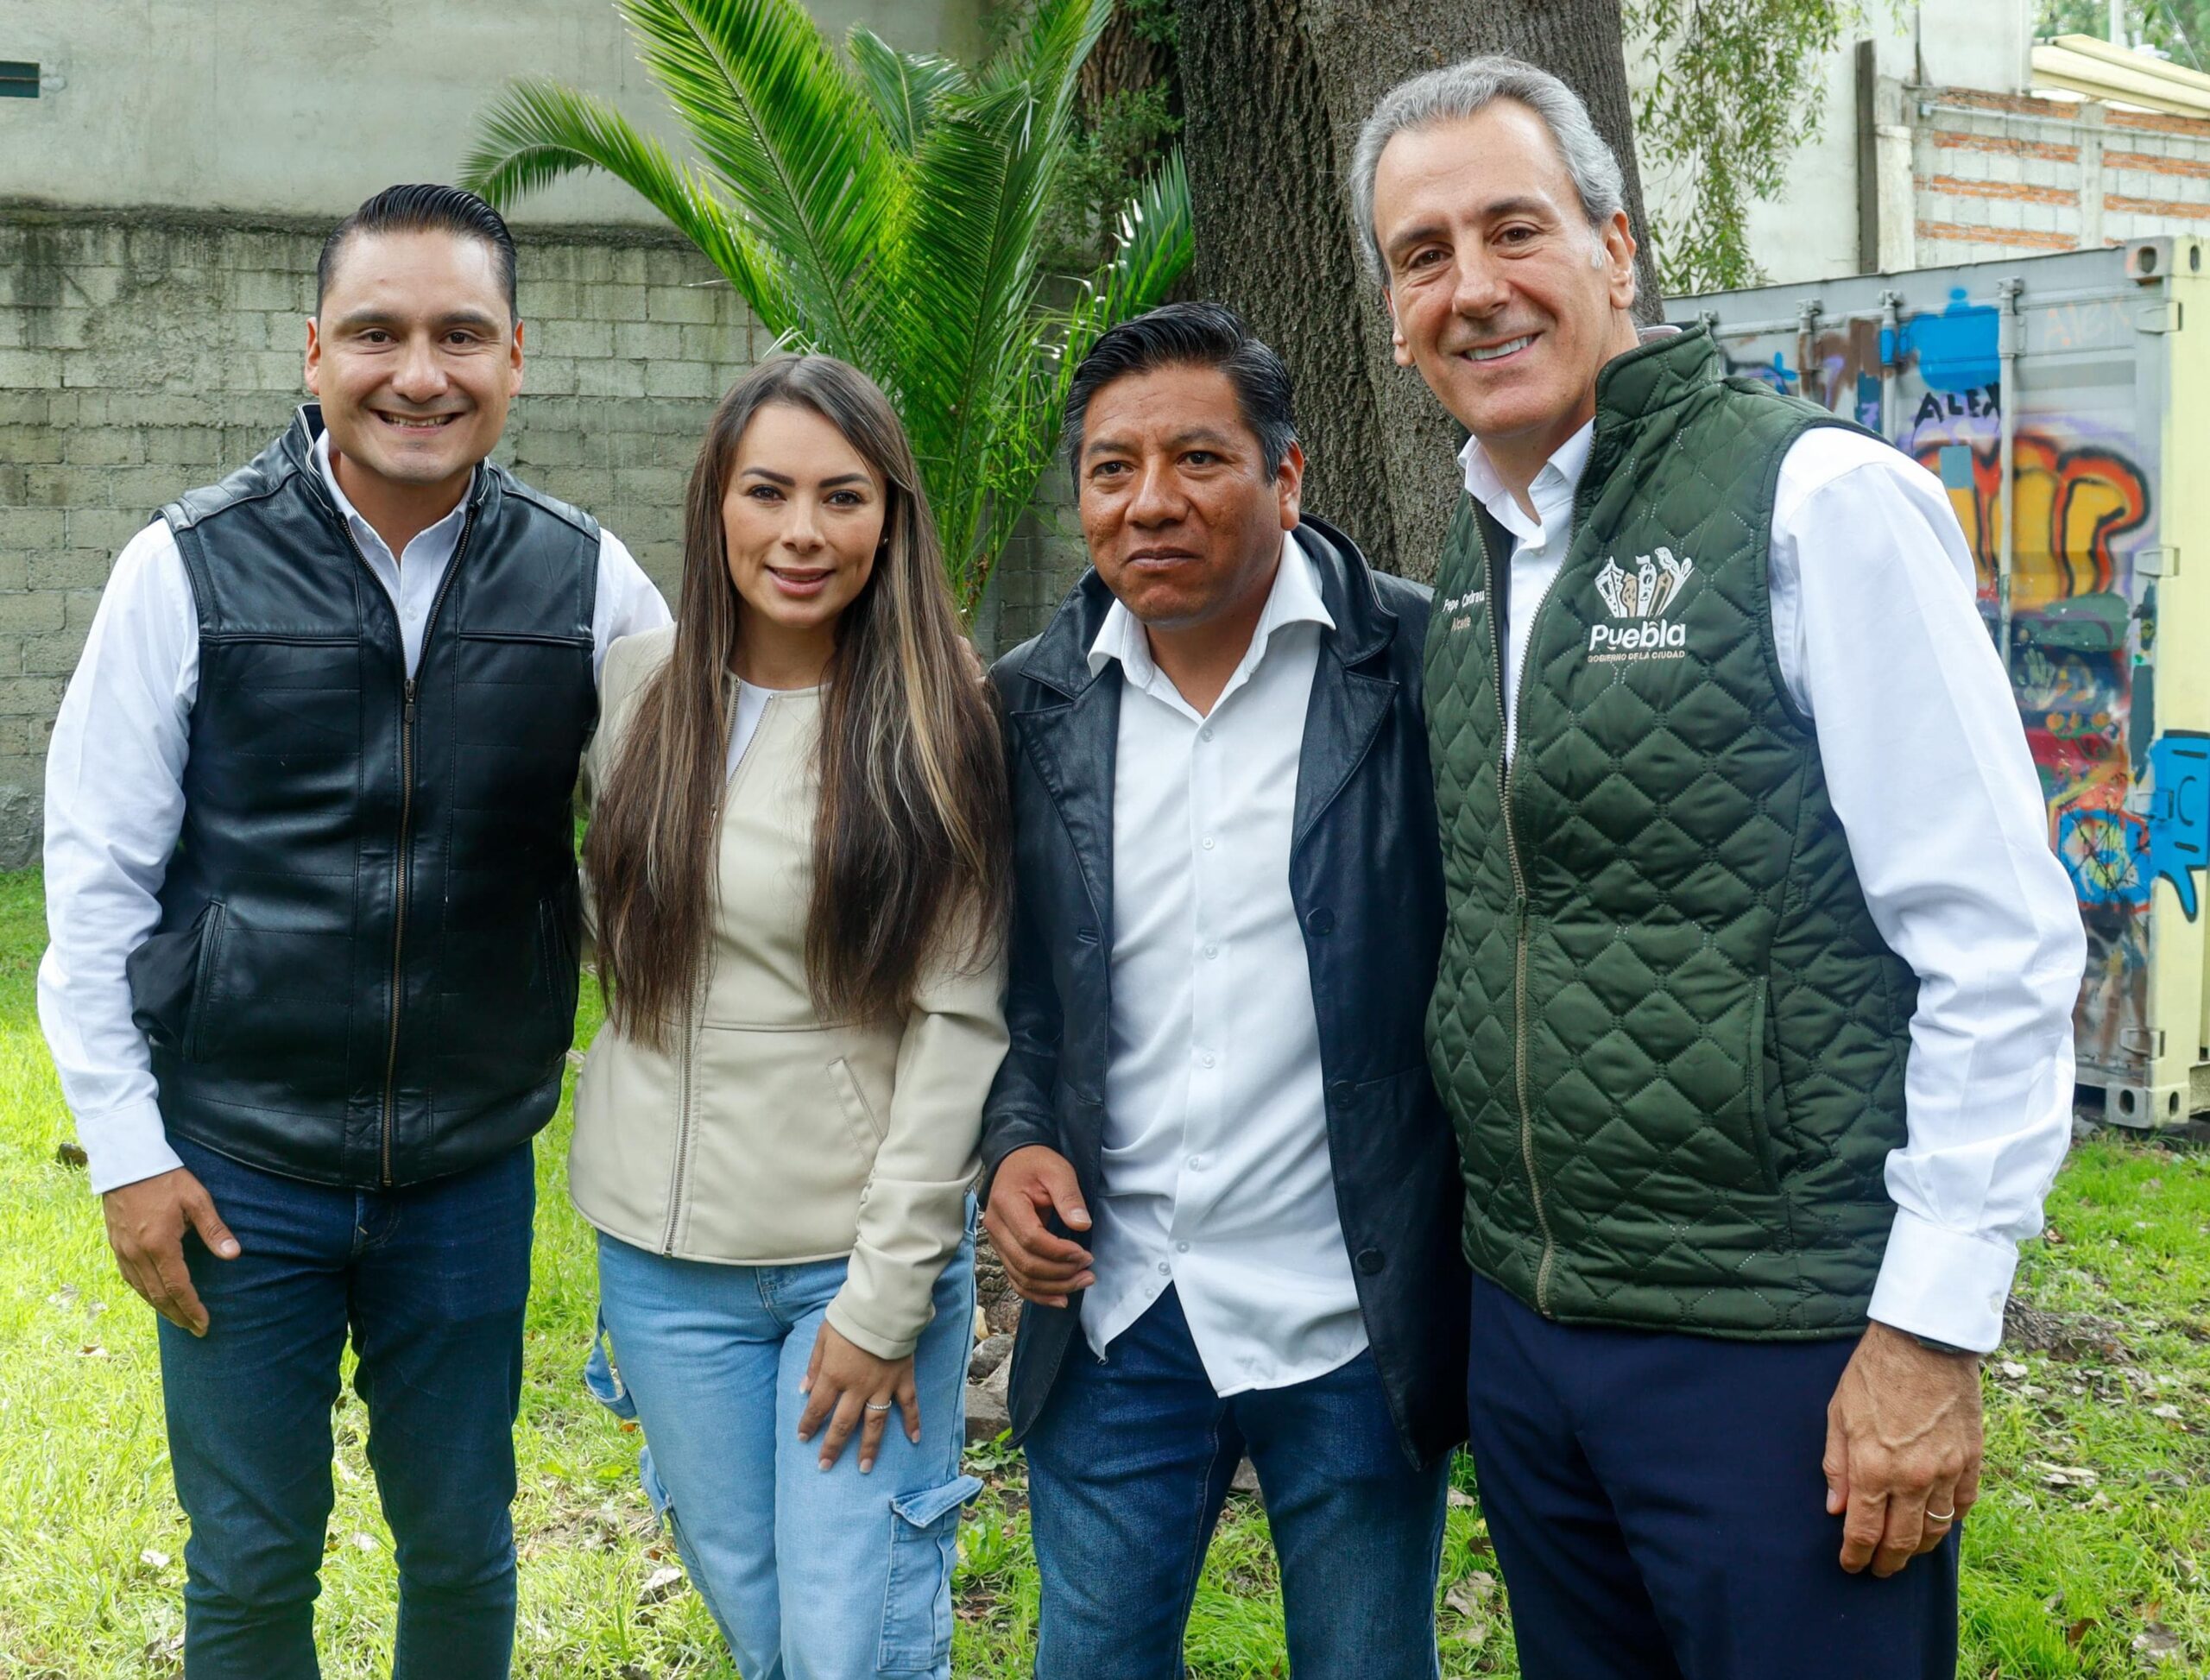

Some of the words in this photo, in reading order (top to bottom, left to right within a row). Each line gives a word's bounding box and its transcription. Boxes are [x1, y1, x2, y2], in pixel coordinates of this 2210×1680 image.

[1914, 382, 2001, 429] ALEX
[1588, 618, 1686, 652] Puebla
[1587, 653, 1627, 663] GOBIERNO
[1651, 650, 1685, 660] CIUDAD
